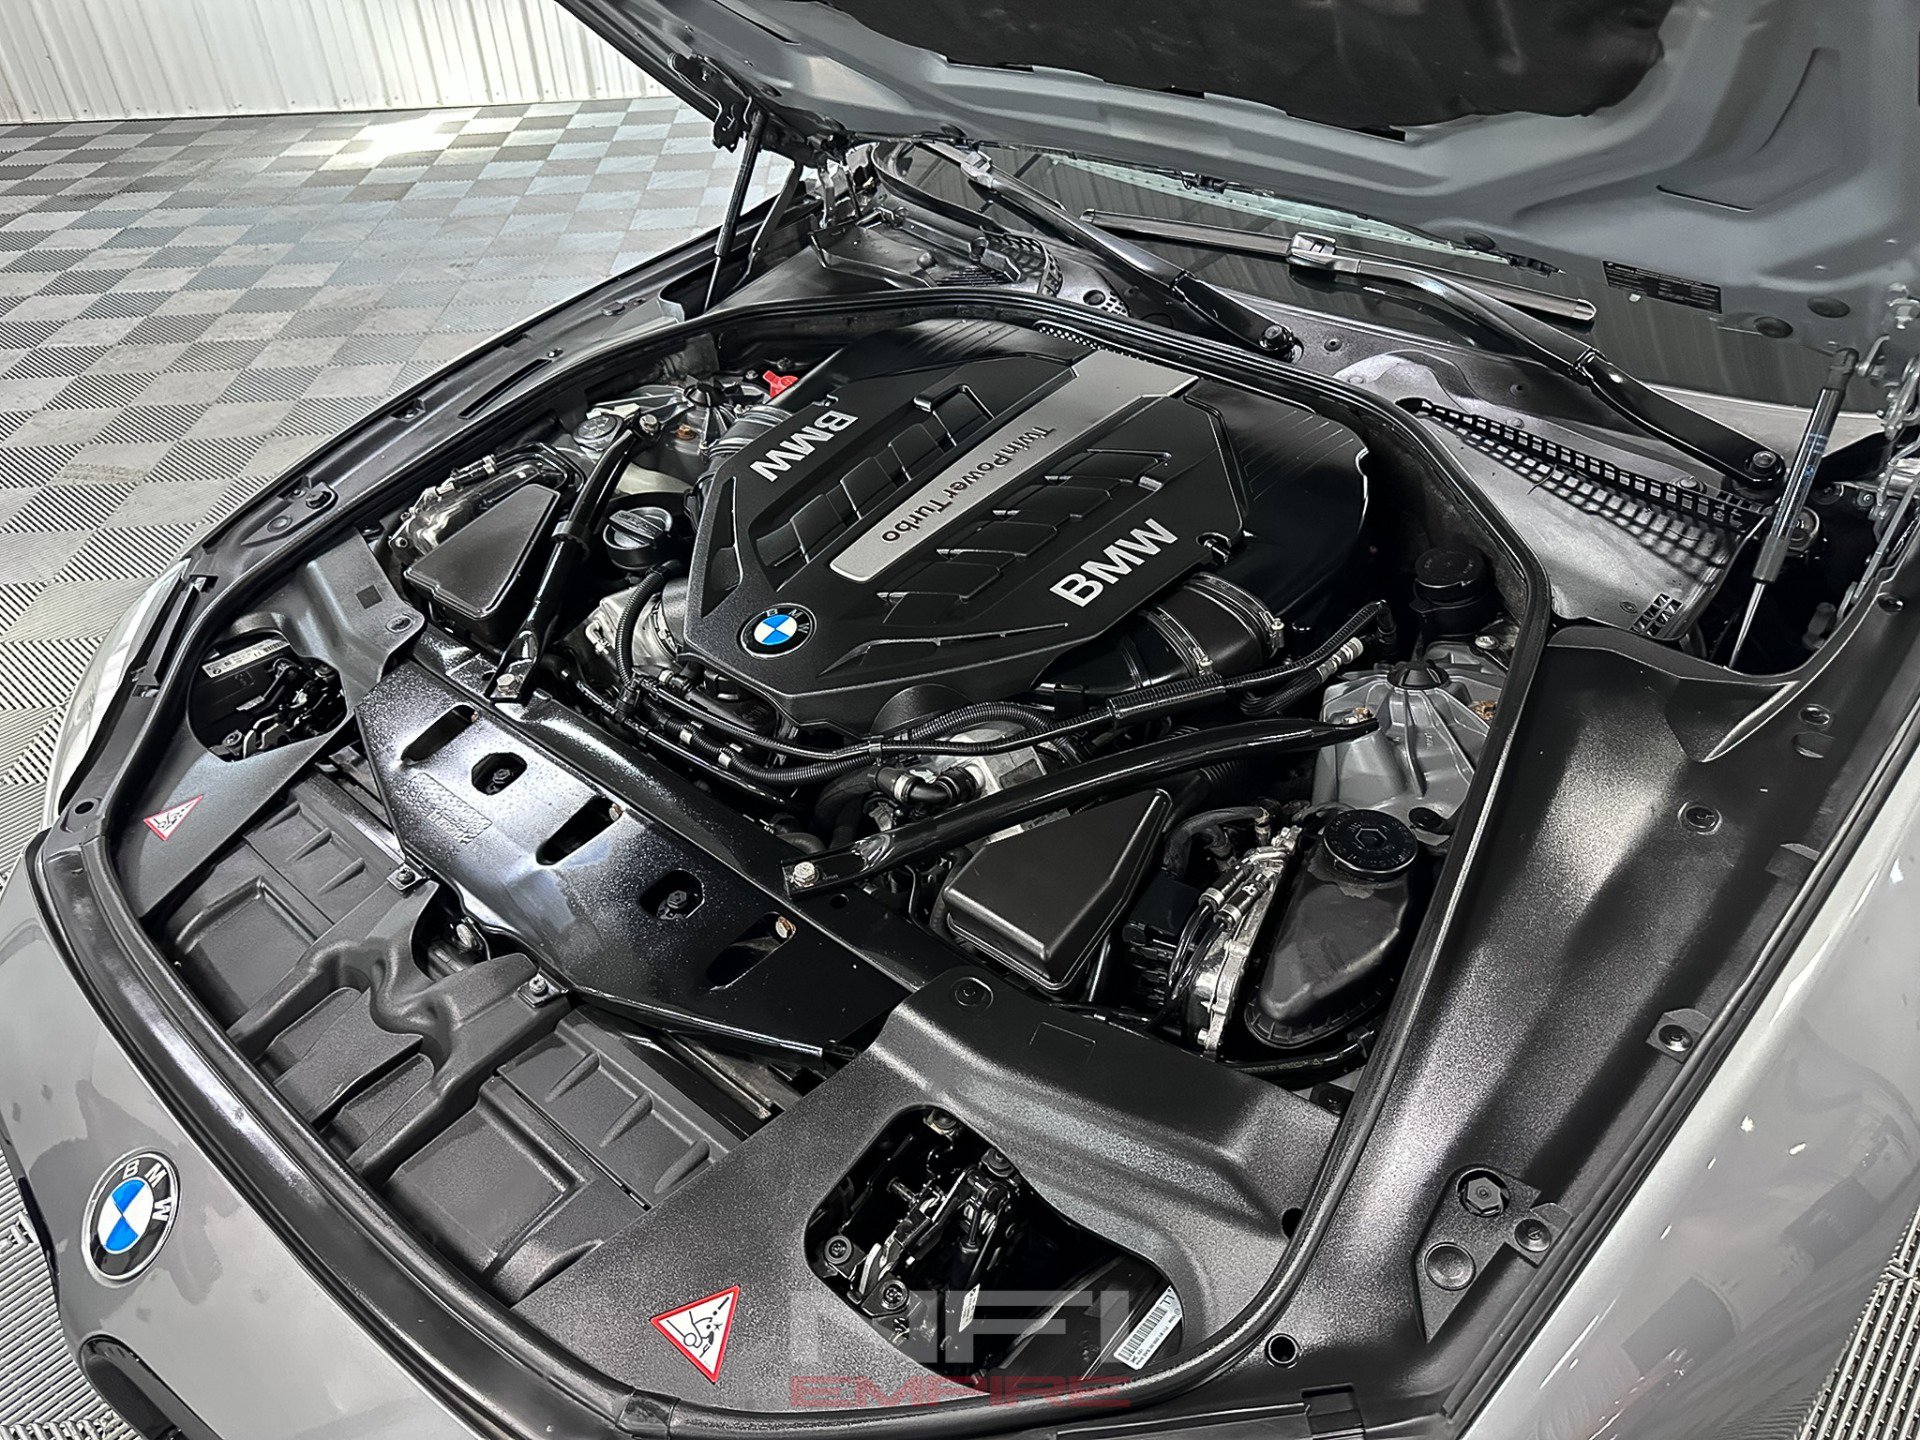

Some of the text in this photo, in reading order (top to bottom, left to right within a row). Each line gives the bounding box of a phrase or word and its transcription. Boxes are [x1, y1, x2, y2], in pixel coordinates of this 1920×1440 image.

[749, 410, 859, 482] BMW
[881, 426, 1056, 542] TwinPower Turbo
[1049, 518, 1179, 607] BMW
[122, 1159, 172, 1221] BMW
